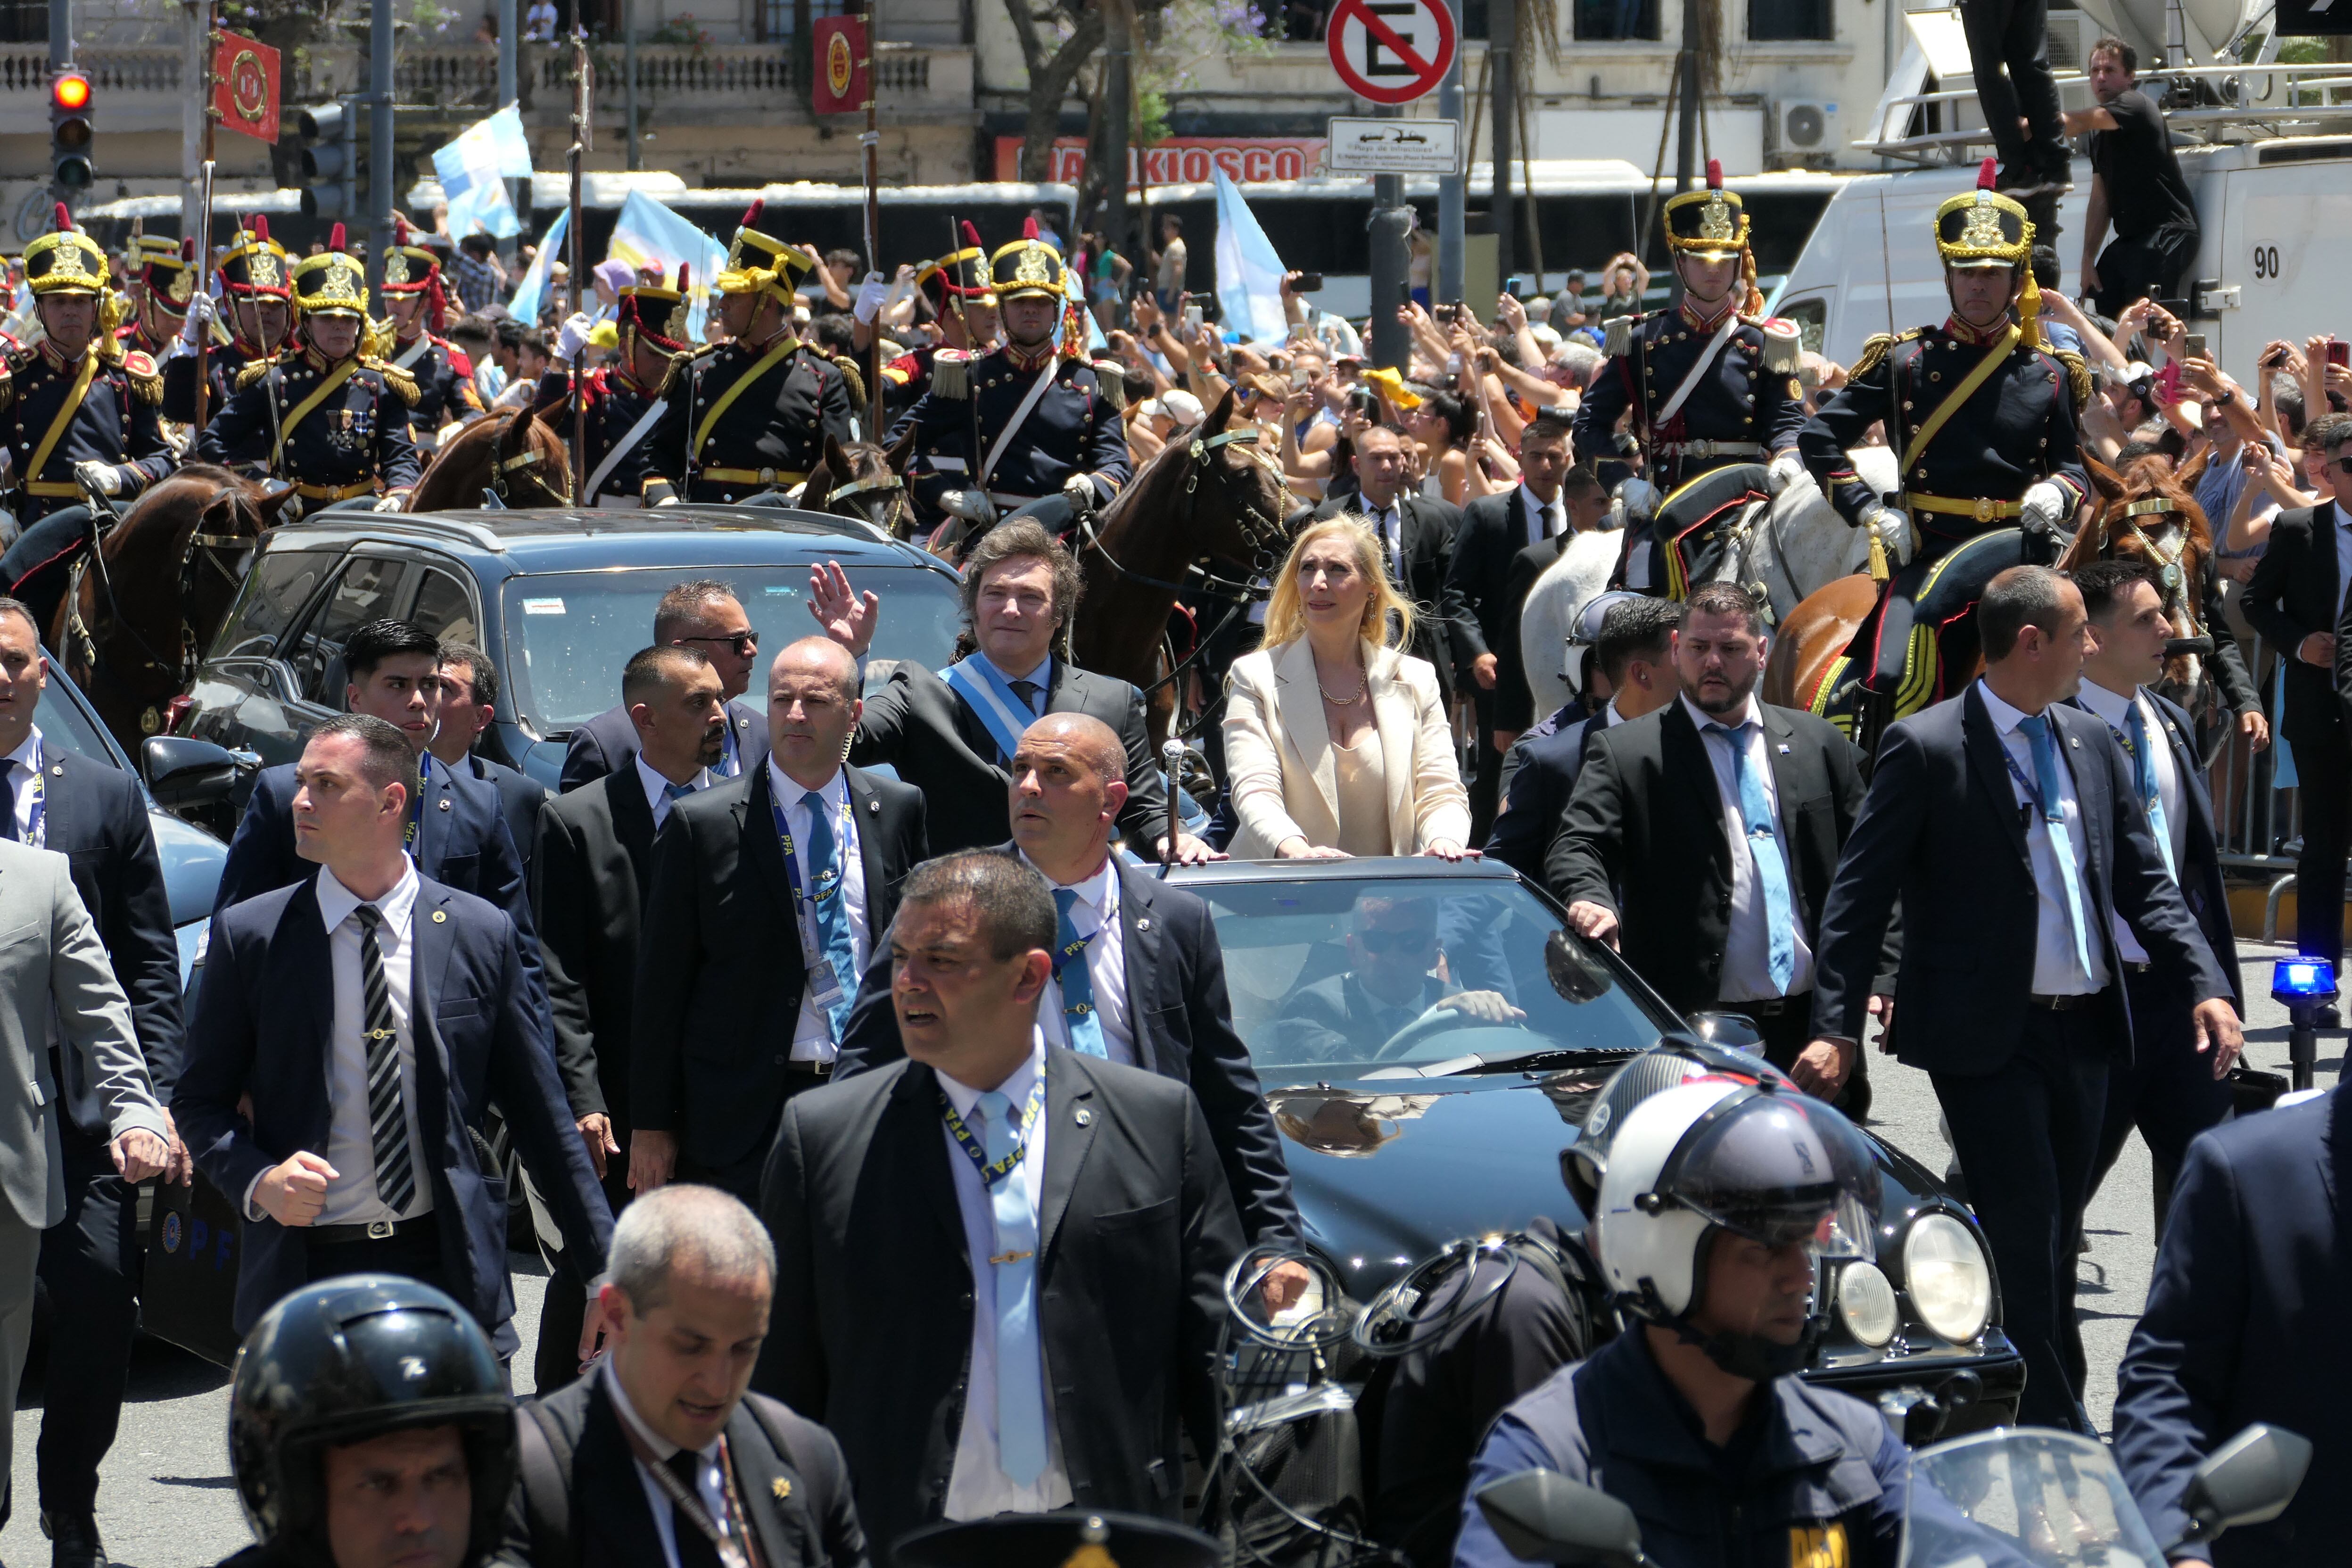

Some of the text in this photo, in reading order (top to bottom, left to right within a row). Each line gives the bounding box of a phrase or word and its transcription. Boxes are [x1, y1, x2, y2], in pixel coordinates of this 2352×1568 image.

[1366, 3, 1419, 75] E
[2255, 247, 2279, 279] 90
[34, 773, 42, 793] PFA
[843, 804, 851, 823] PFA
[405, 821, 416, 842] PFA
[781, 835, 794, 856] PFA
[814, 888, 833, 901] PFA
[1064, 941, 1087, 956] PFA
[1022, 1097, 1040, 1129] PFA
[945, 1108, 971, 1141] PFA
[993, 1147, 1024, 1174] PFA
